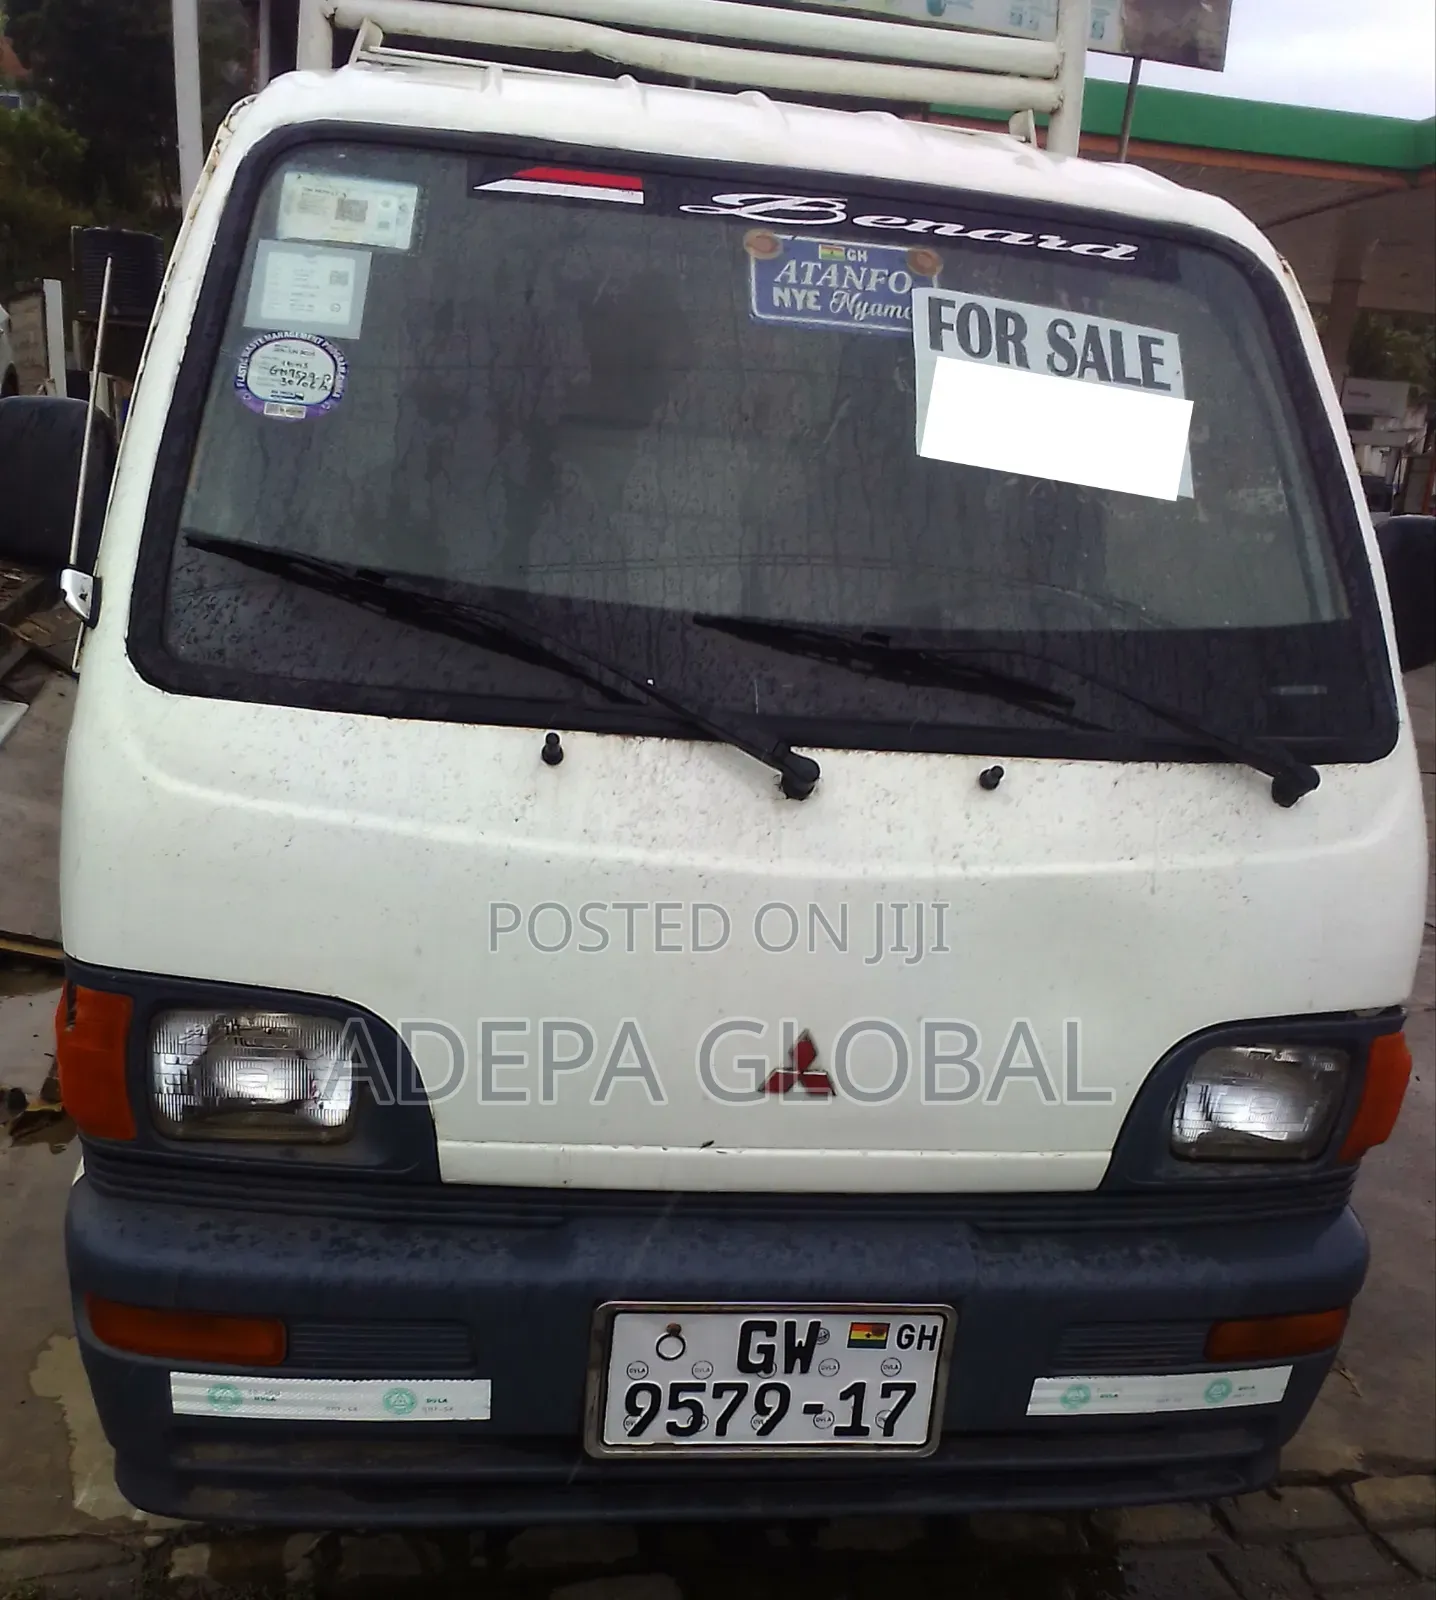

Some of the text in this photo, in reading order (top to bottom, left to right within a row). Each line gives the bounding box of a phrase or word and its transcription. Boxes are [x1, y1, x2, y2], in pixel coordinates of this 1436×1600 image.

[679, 193, 1138, 260] Benard
[774, 260, 912, 294] ATANFO
[846, 250, 869, 263] GH
[773, 287, 821, 311] NYE
[928, 297, 1171, 390] FOR SALE
[737, 1319, 821, 1374] GW
[896, 1323, 939, 1351] GH
[625, 1382, 917, 1437] 9579-17
